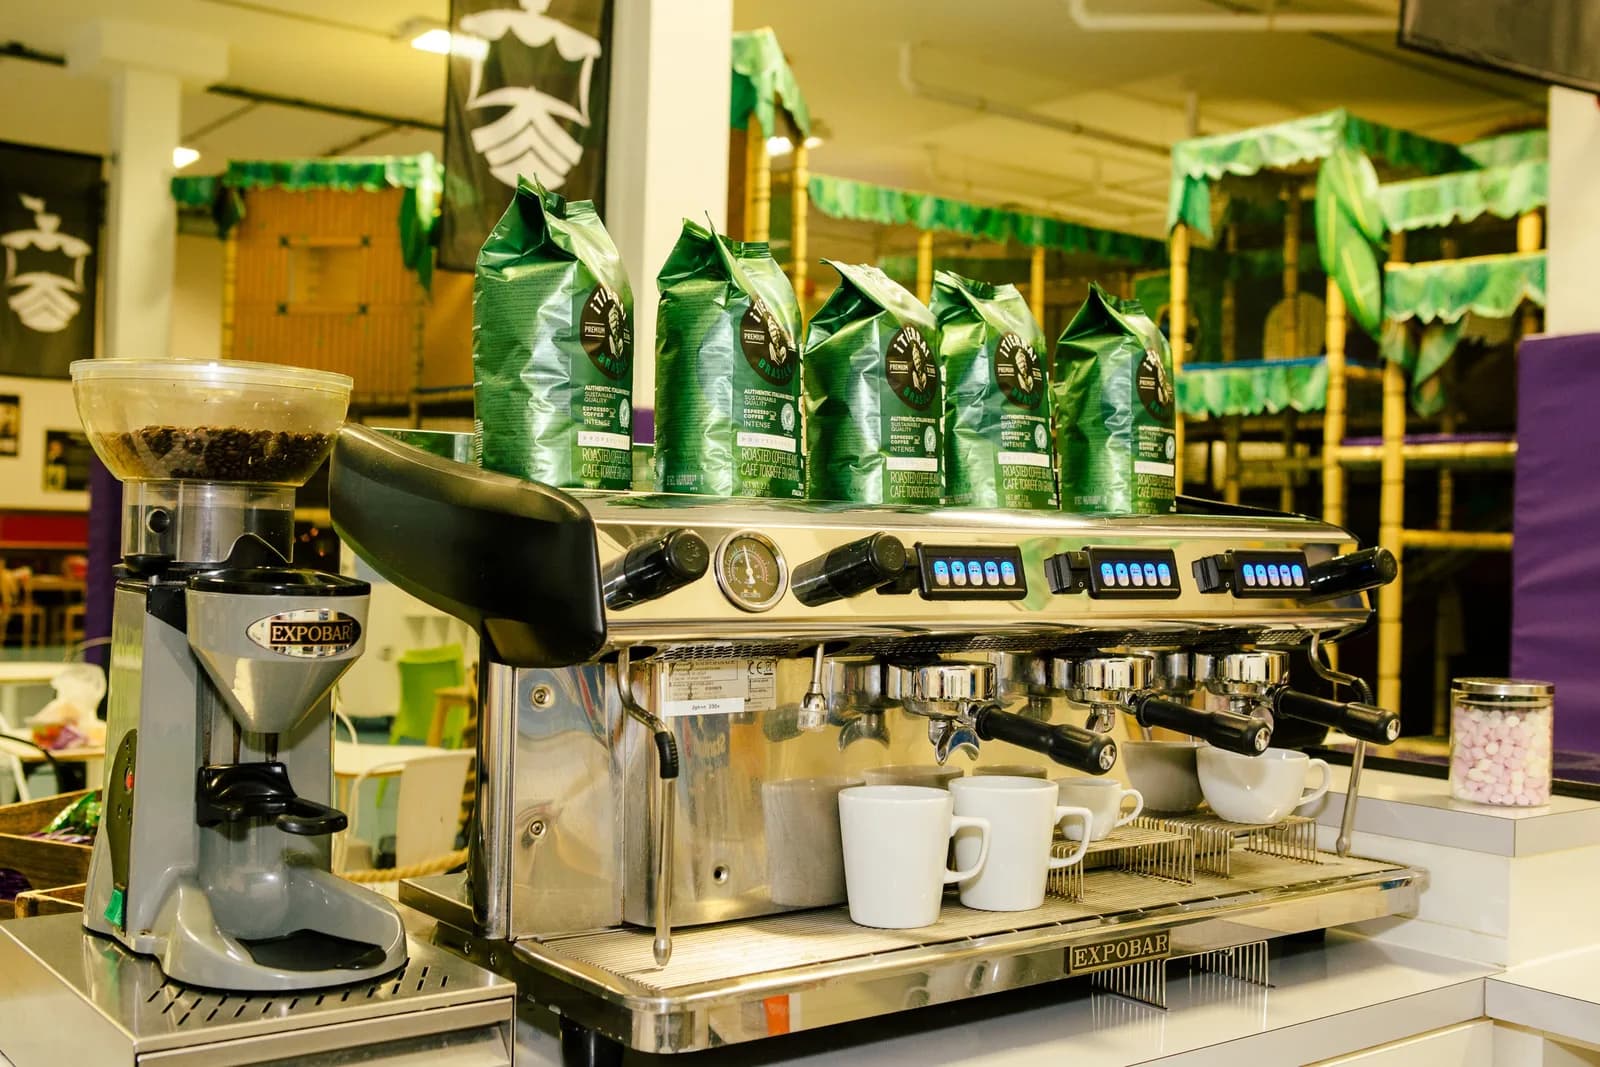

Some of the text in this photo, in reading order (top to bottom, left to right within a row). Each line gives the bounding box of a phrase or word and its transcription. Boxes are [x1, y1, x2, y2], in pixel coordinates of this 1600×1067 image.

[584, 326, 605, 334] PREMIUM
[744, 333, 765, 341] PREMIUM
[743, 420, 771, 429] INTENSE
[582, 448, 610, 463] ROASTED
[742, 448, 771, 462] ROASTED
[1002, 465, 1027, 477] ROASTED
[891, 472, 916, 484] ROASTED
[272, 625, 350, 641] EXPOBAR
[1074, 934, 1168, 968] EXPOBAR
